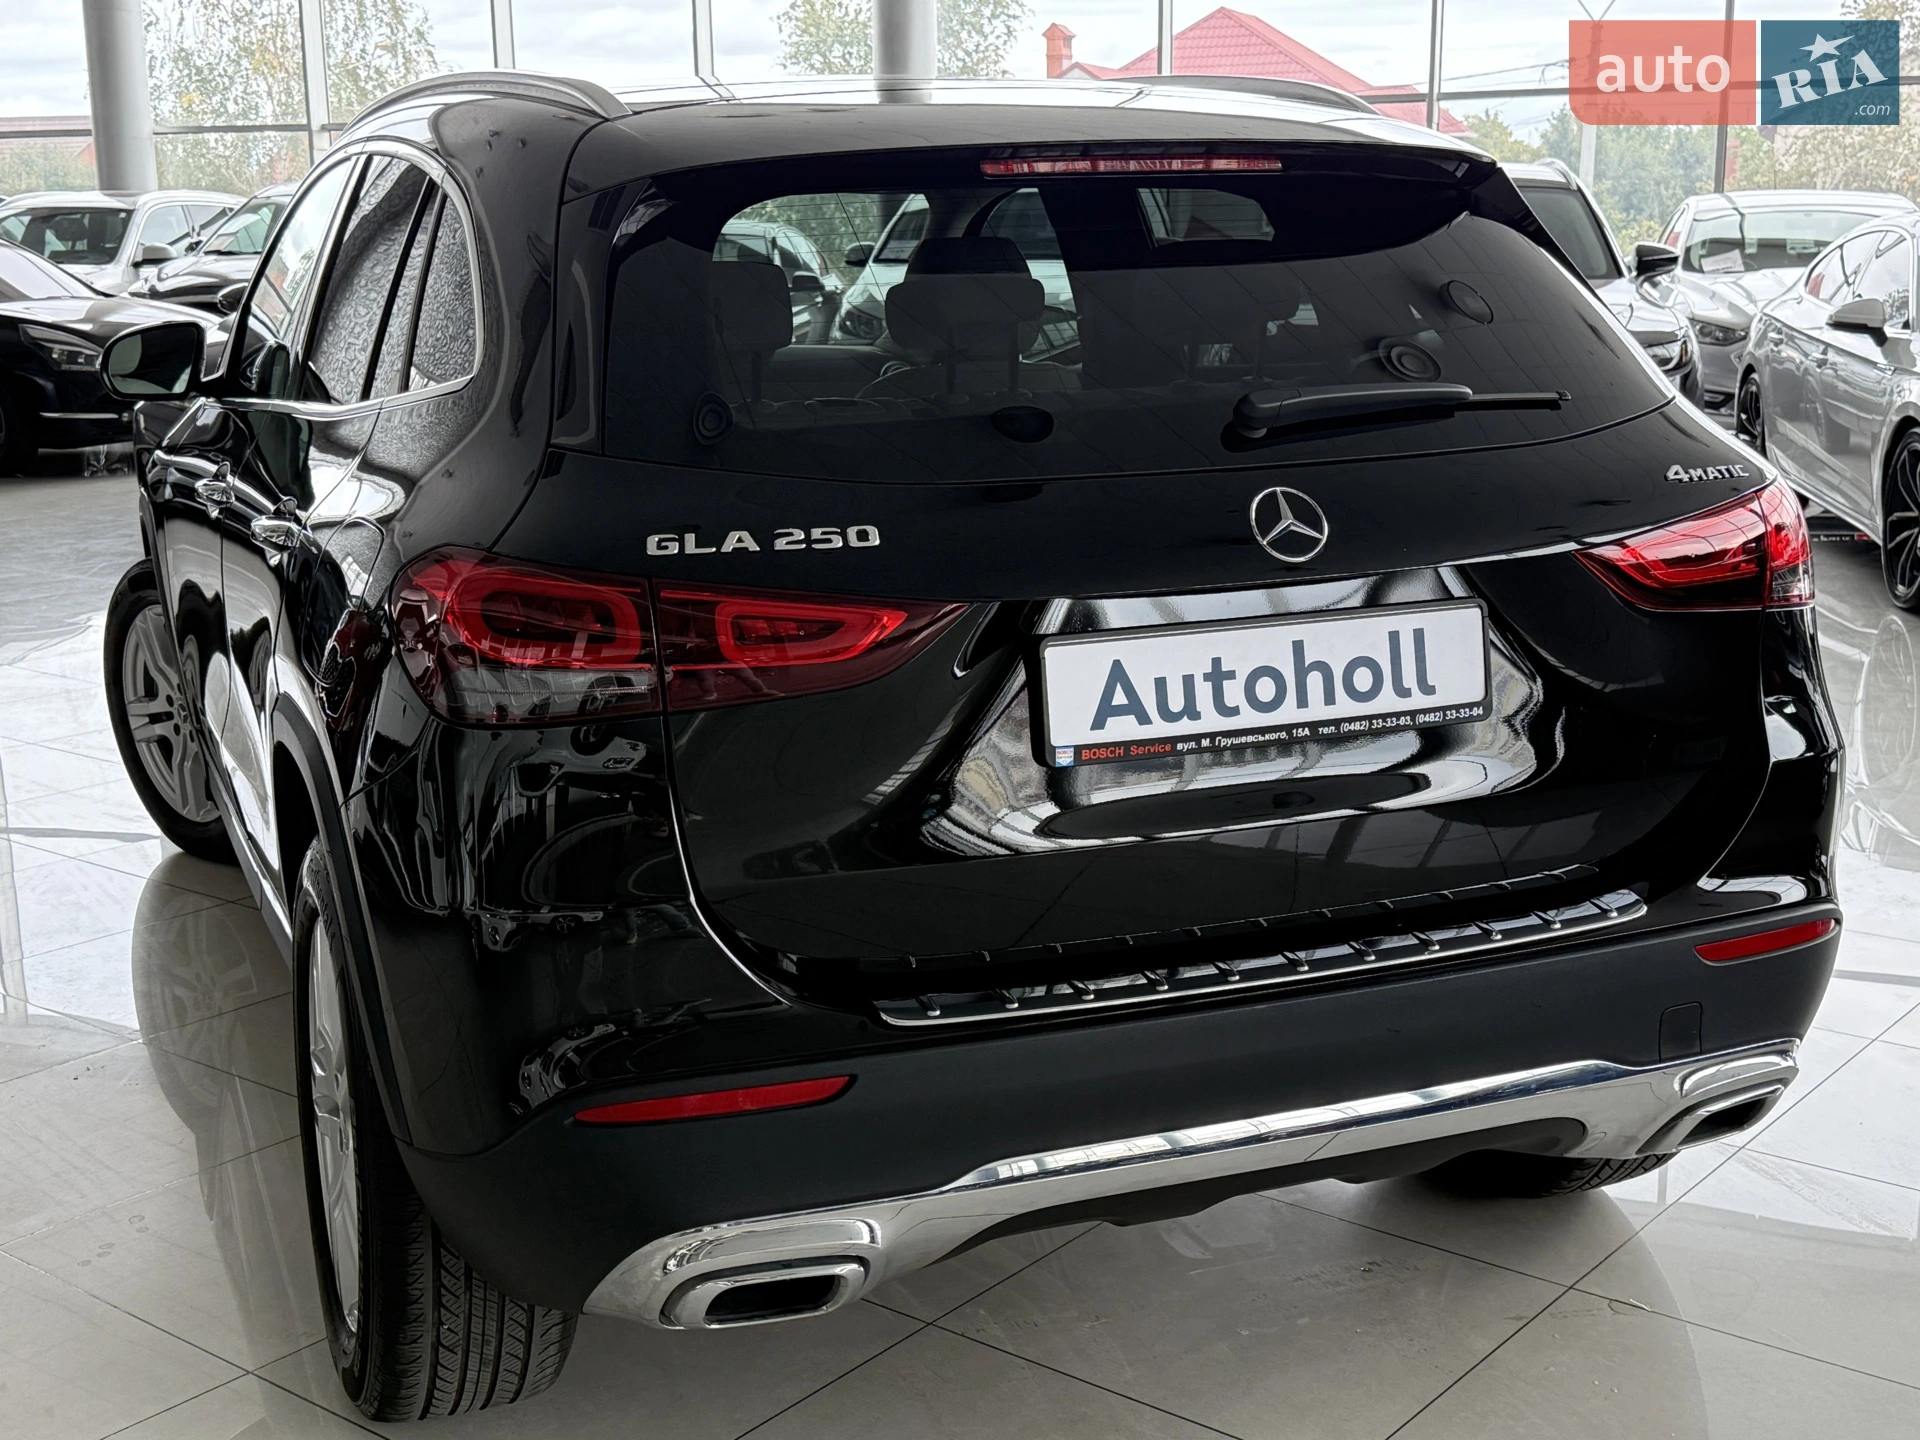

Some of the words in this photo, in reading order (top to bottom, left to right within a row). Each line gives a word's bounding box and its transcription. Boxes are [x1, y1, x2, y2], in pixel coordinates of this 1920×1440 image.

[1665, 464, 1750, 483] 4MATIC
[646, 530, 761, 556] GLA
[773, 525, 880, 551] 250
[1089, 627, 1437, 731] Autoholl
[1176, 741, 1198, 752] вул.
[1201, 737, 1213, 748] М.
[1215, 731, 1289, 748] Грушевського,
[1318, 724, 1338, 735] тел.
[1340, 718, 1370, 734] (0482)
[1371, 715, 1414, 730] 33-33-03,
[1416, 710, 1444, 726] (0482)
[1445, 706, 1484, 720] 33-33-04
[1081, 747, 1124, 761] BOSCH
[1129, 742, 1172, 757] Service
